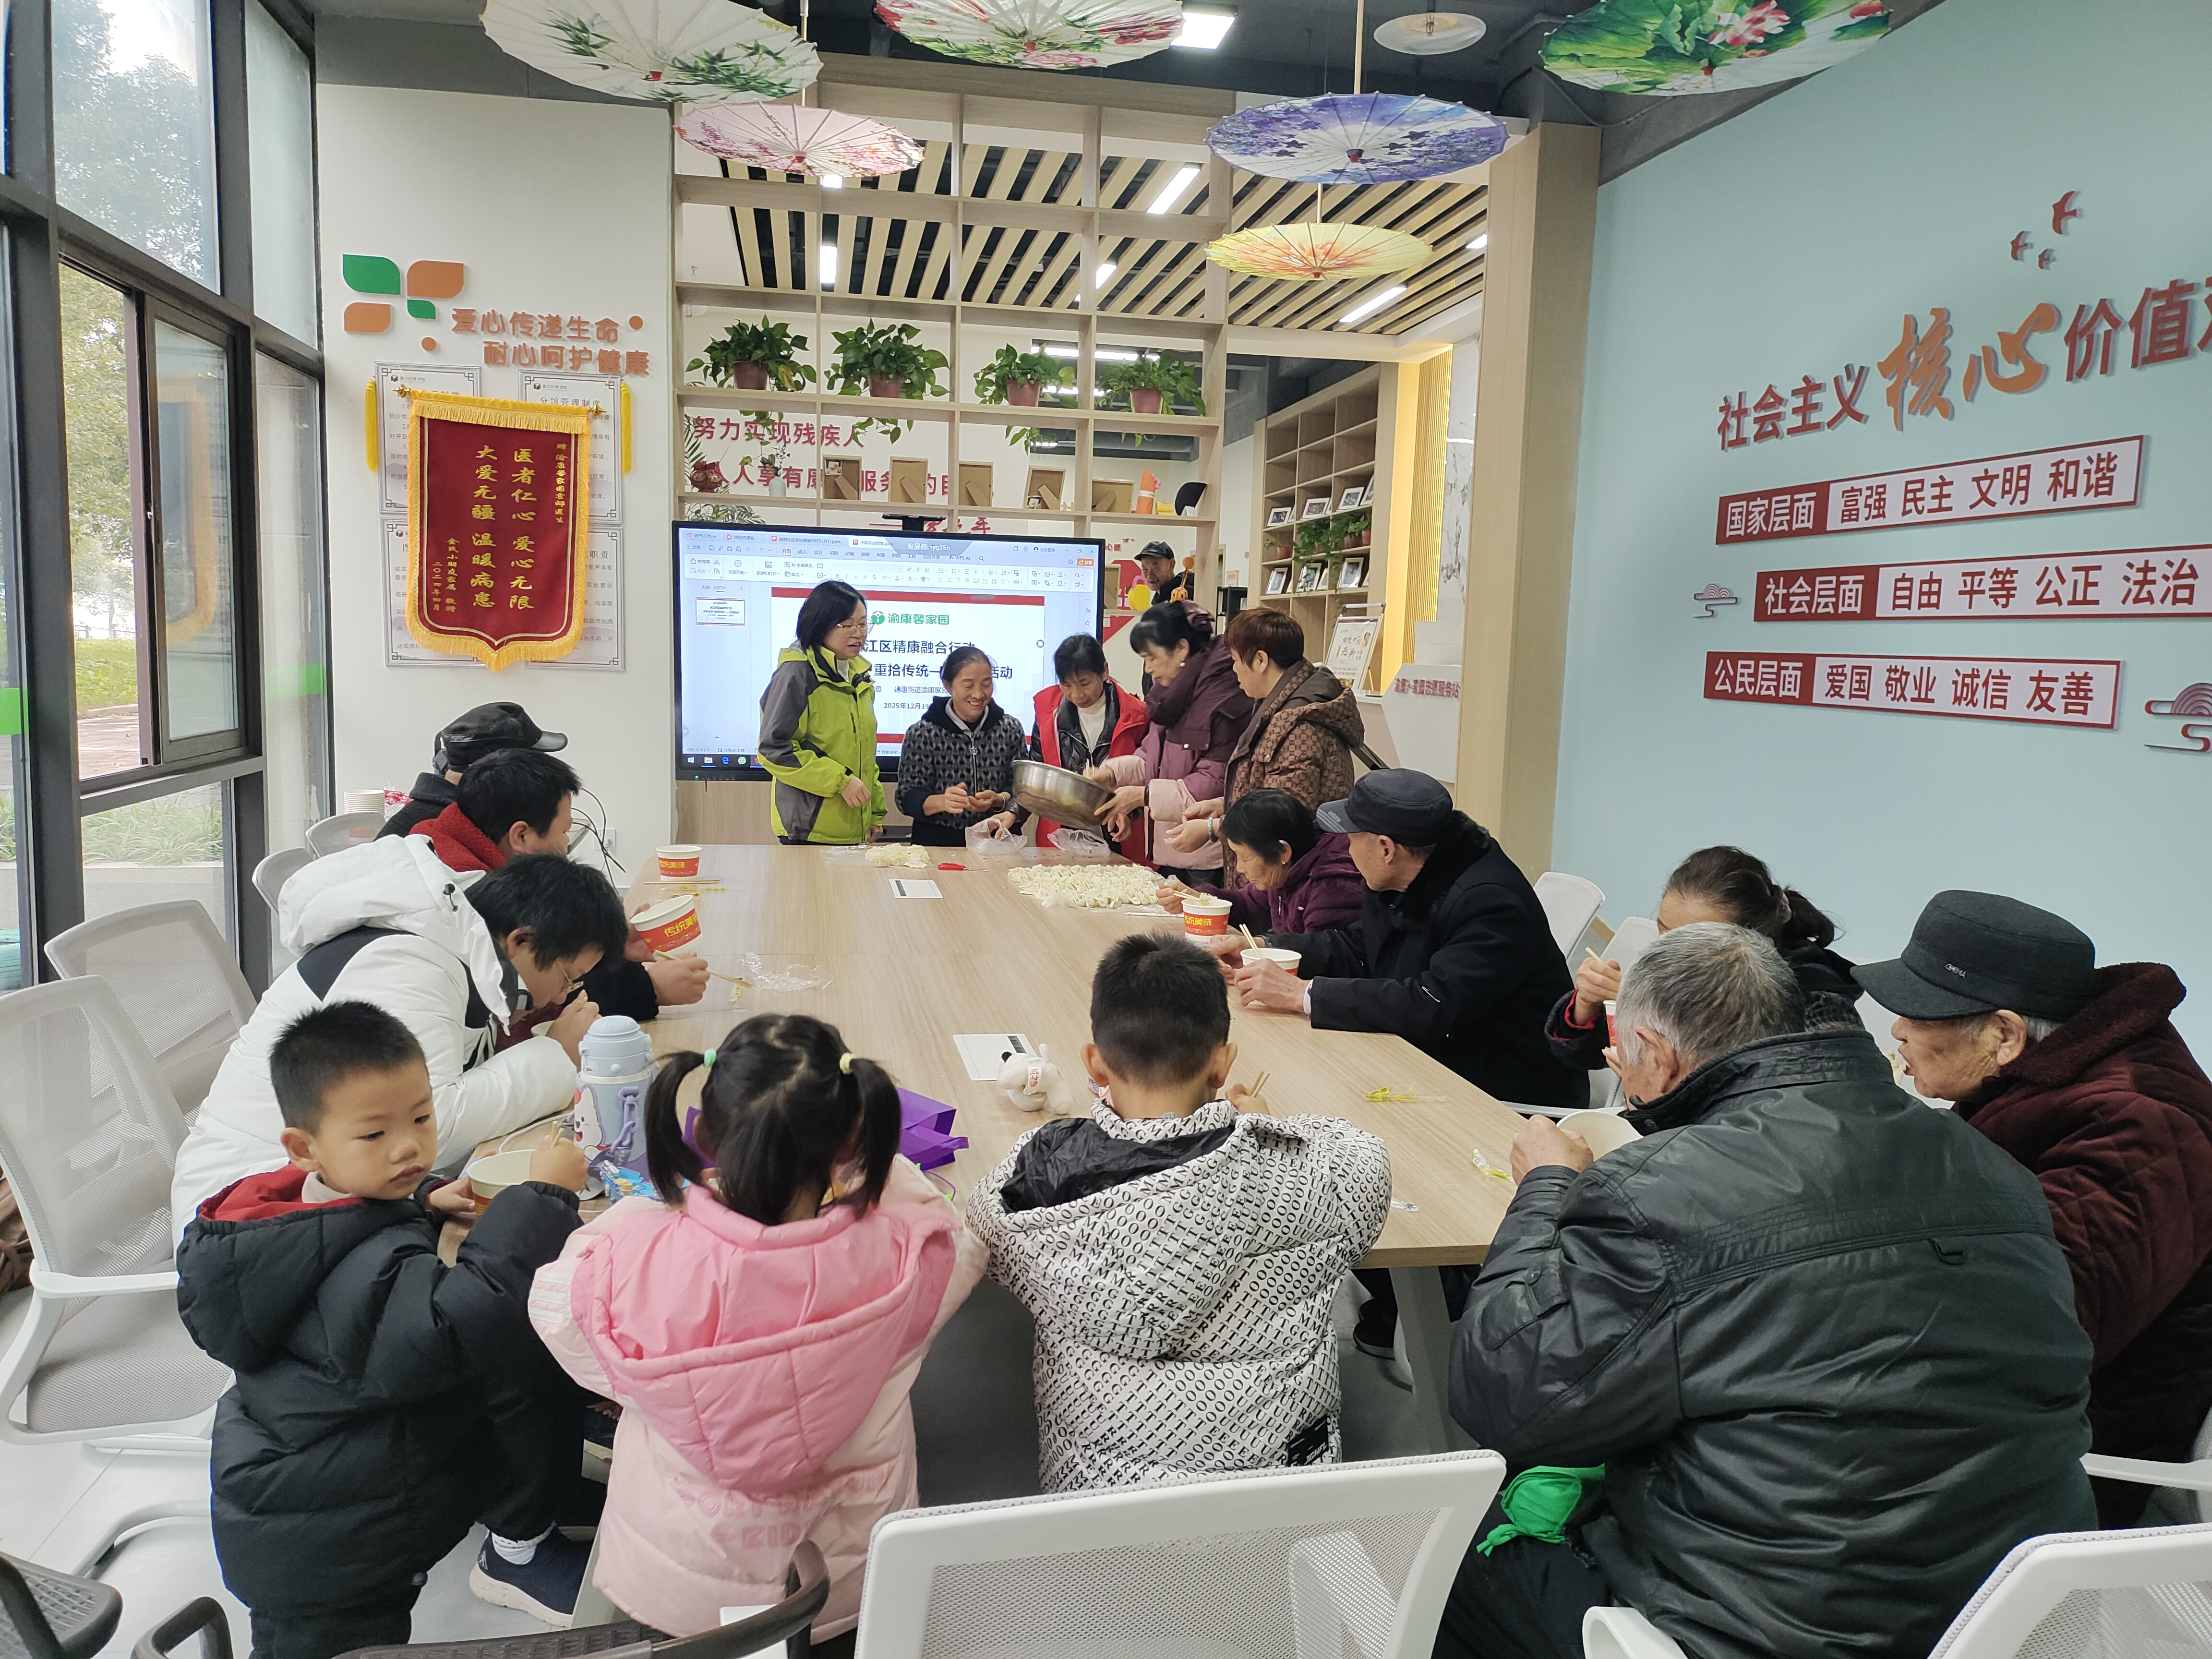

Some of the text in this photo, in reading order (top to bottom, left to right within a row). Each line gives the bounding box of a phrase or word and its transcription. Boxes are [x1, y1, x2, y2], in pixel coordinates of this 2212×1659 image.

[451, 308, 619, 343] 爱心传递生命
[483, 340, 650, 375] 耐心呵护健康
[693, 415, 865, 448] 努力实现残疾人
[1725, 451, 2118, 538] 国家层面 富强 民主 文明 和谐
[470, 445, 498, 608] 大爱无疆 温暖病患
[509, 448, 537, 610] 医者仁心 爱心无限
[1765, 558, 2200, 615] 社会层面 自由 平等 公正 法治
[888, 613, 950, 625] 渝康馨家园
[861, 639, 975, 655] 江区精康融合行
[1714, 659, 2095, 717] 公民层面 爱国 敬业 诚信 友善
[659, 859, 685, 868] 传统美味
